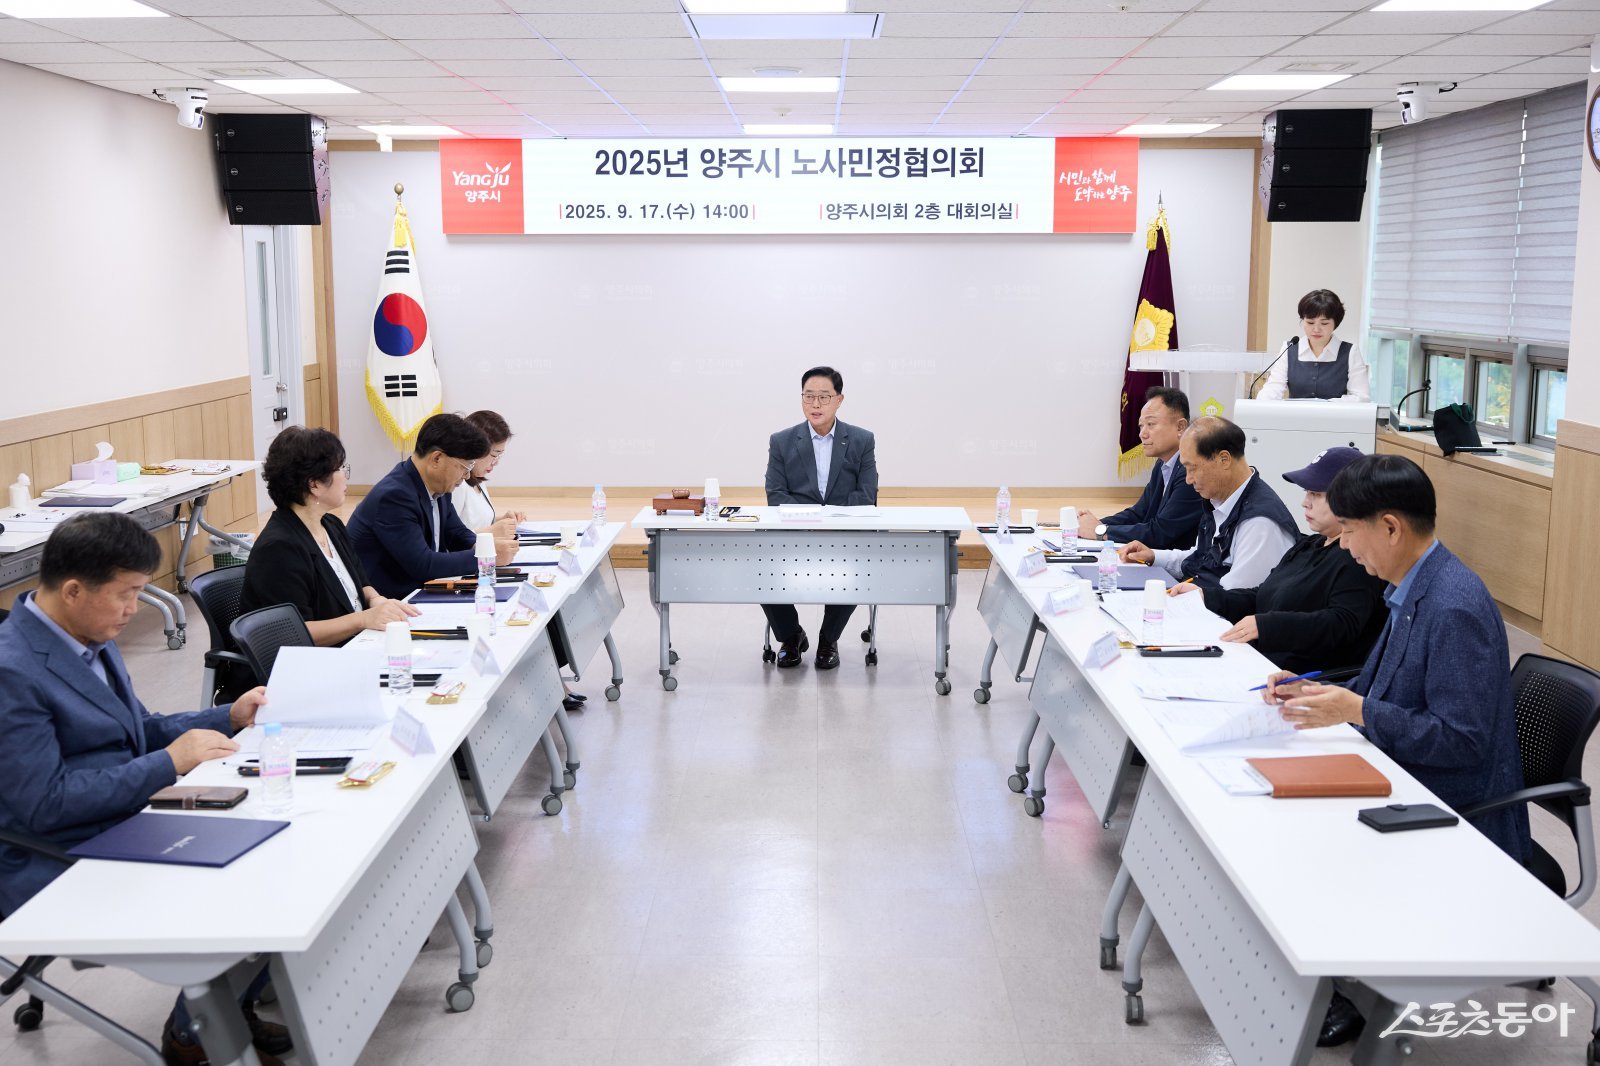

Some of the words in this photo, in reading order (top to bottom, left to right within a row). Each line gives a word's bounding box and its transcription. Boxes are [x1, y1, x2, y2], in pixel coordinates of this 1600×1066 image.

[595, 147, 689, 178] 2025년
[699, 147, 781, 179] 양주시
[790, 146, 985, 179] 노사민정협의회
[1091, 168, 1117, 186] 함께
[464, 190, 501, 203] 양주시
[1106, 185, 1133, 202] 양주
[565, 204, 611, 219] 2025.
[617, 204, 633, 219] 9.
[703, 204, 749, 219] 14:00
[825, 202, 908, 221] 양주시의회
[914, 202, 942, 221] 2층
[946, 202, 1013, 220] 대회의실
